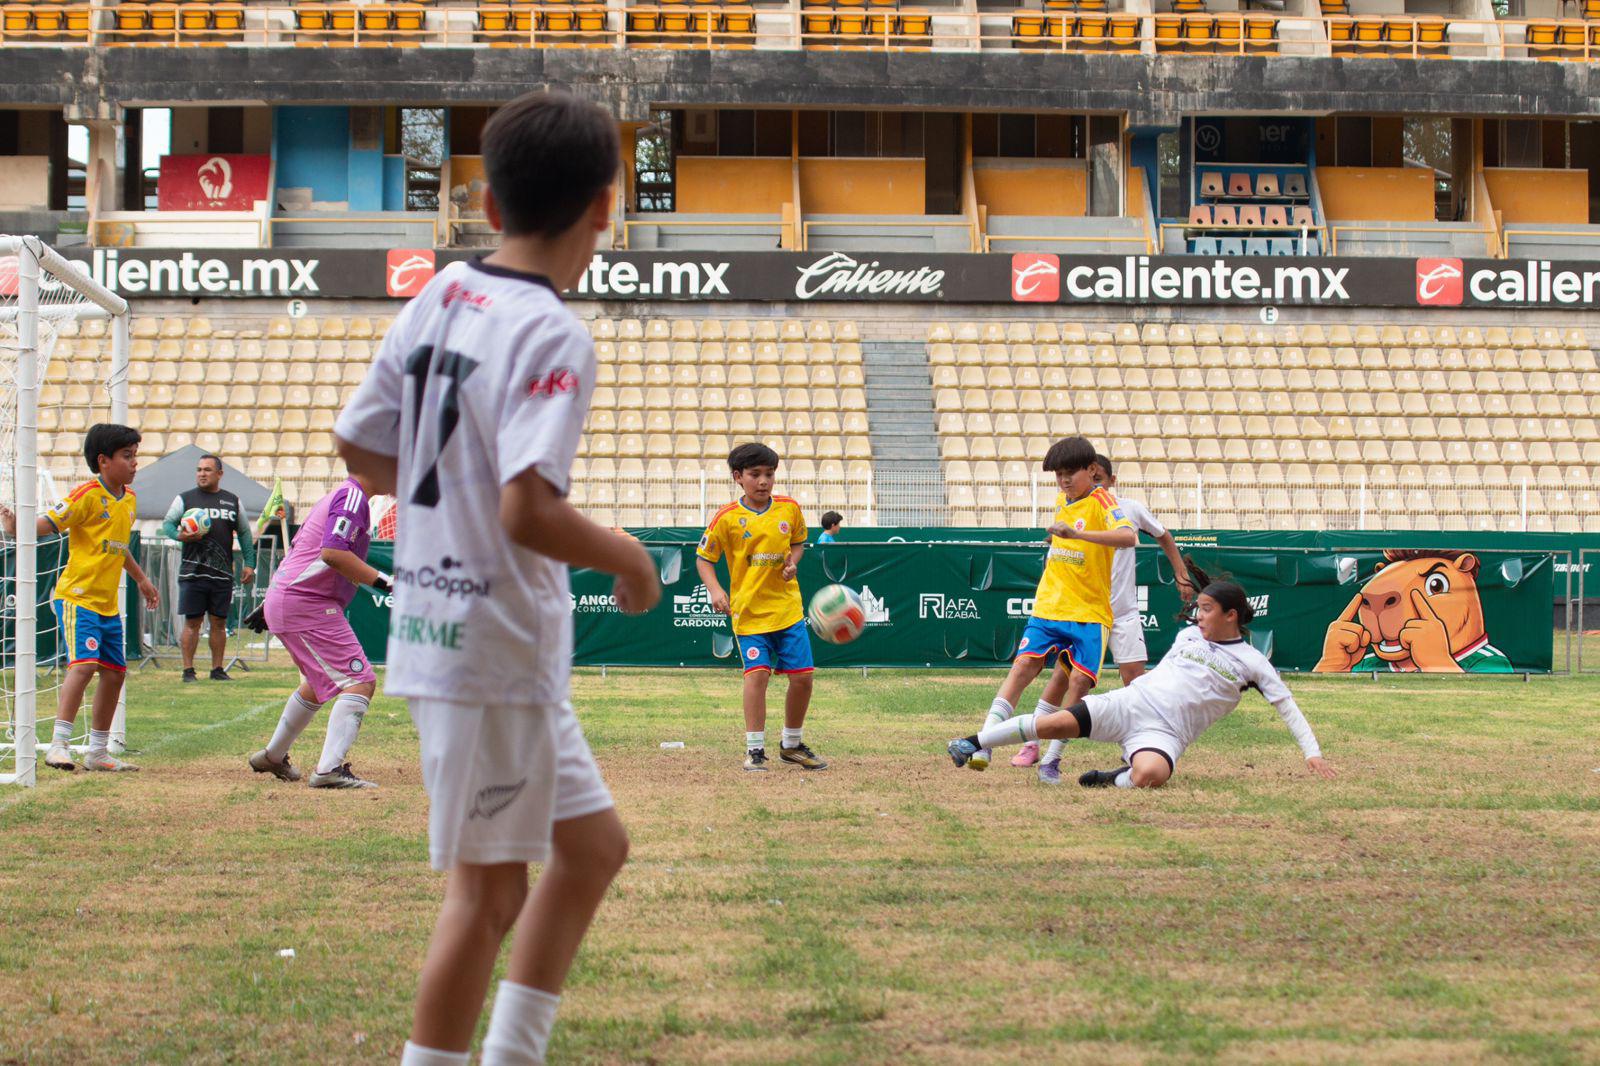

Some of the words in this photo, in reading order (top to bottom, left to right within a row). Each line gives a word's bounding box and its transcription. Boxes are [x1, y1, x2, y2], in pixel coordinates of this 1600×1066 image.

[795, 251, 946, 299] Caliente
[1066, 256, 1350, 299] caliente.mx
[292, 303, 301, 315] F
[1265, 307, 1274, 320] E
[578, 595, 618, 605] ANGO
[1006, 598, 1033, 615] CO
[945, 611, 981, 619] IZABAL
[673, 619, 727, 627] CARDONA
[398, 615, 466, 650] FIRME
